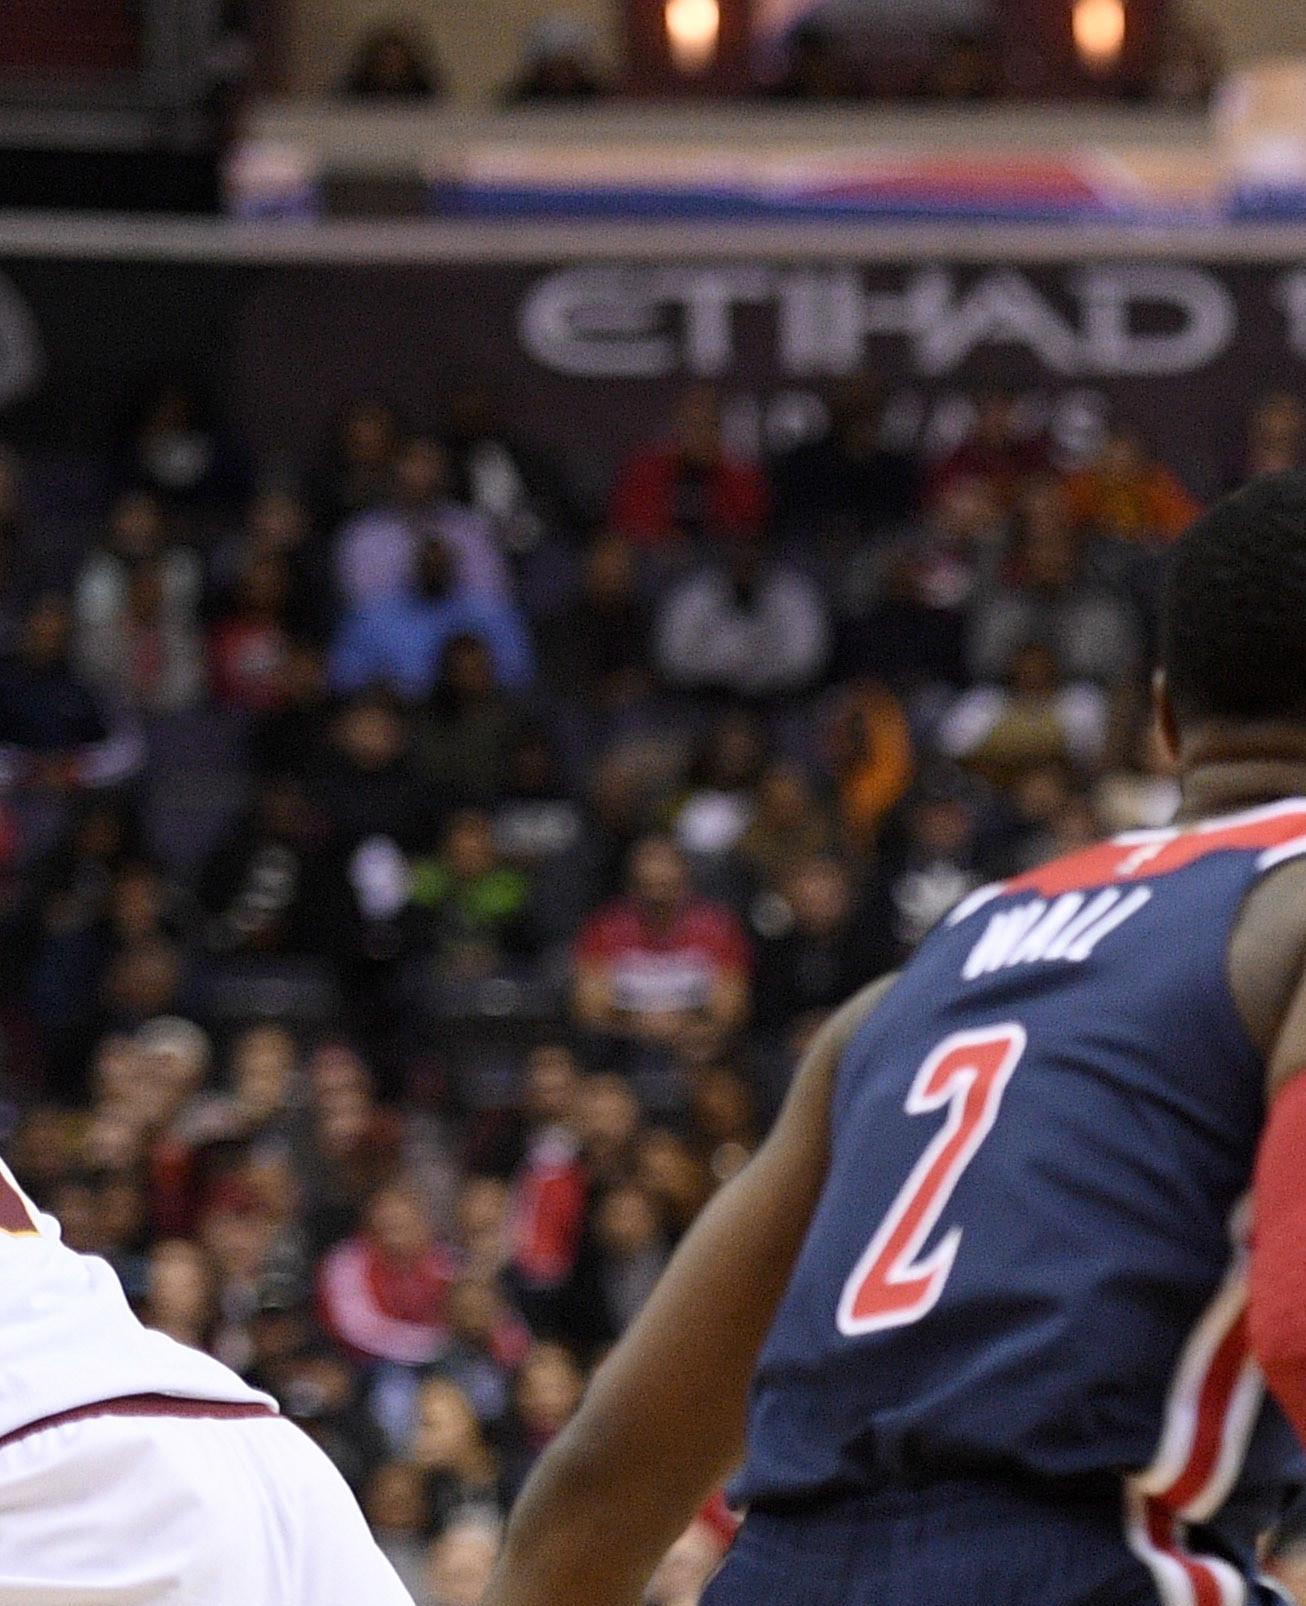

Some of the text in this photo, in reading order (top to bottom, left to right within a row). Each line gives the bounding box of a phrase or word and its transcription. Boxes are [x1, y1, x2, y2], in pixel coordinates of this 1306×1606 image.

[520, 266, 1236, 378] ETIHAD
[962, 886, 1153, 982] WALL
[837, 1021, 1028, 1338] 2
